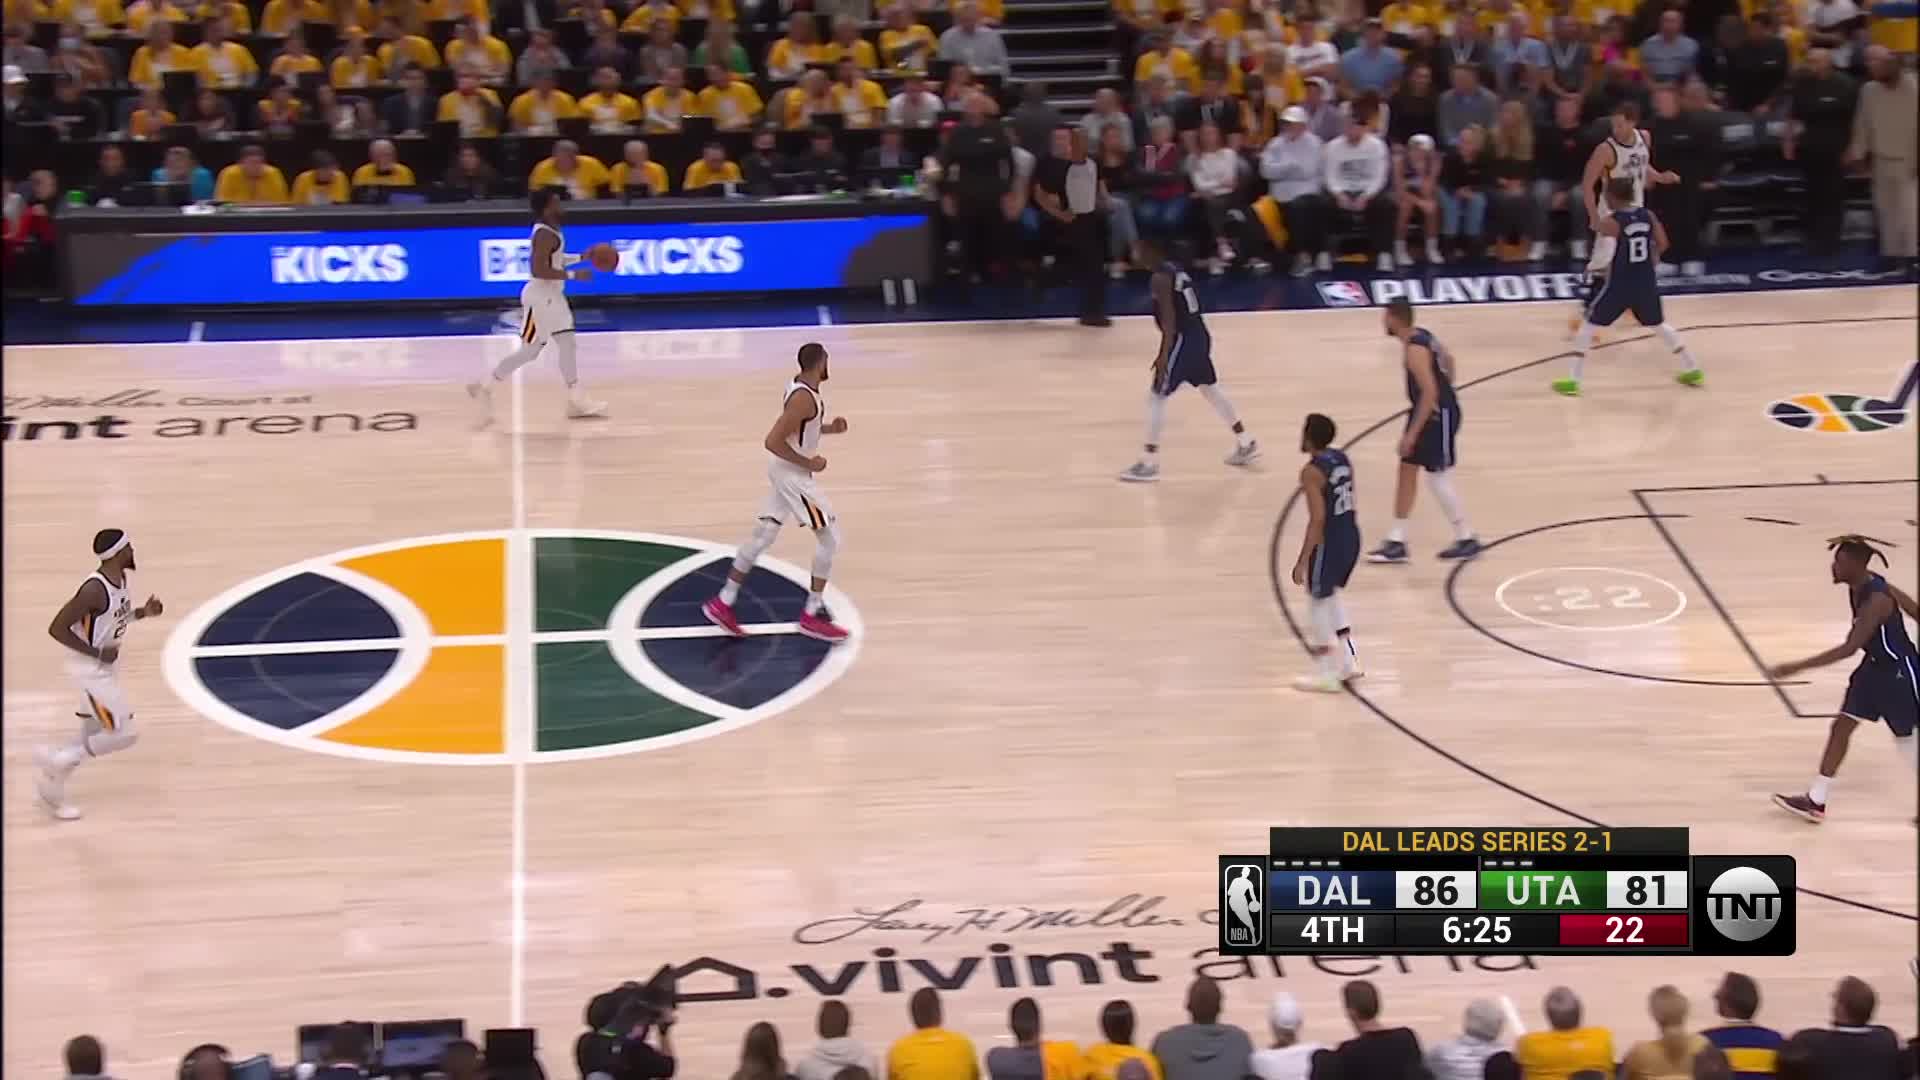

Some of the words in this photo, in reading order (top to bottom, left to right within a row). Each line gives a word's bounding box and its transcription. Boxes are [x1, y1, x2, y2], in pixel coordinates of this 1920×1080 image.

[270, 244, 408, 284] KICKS
[611, 235, 744, 276] KICKS
[155, 412, 417, 438] arena
